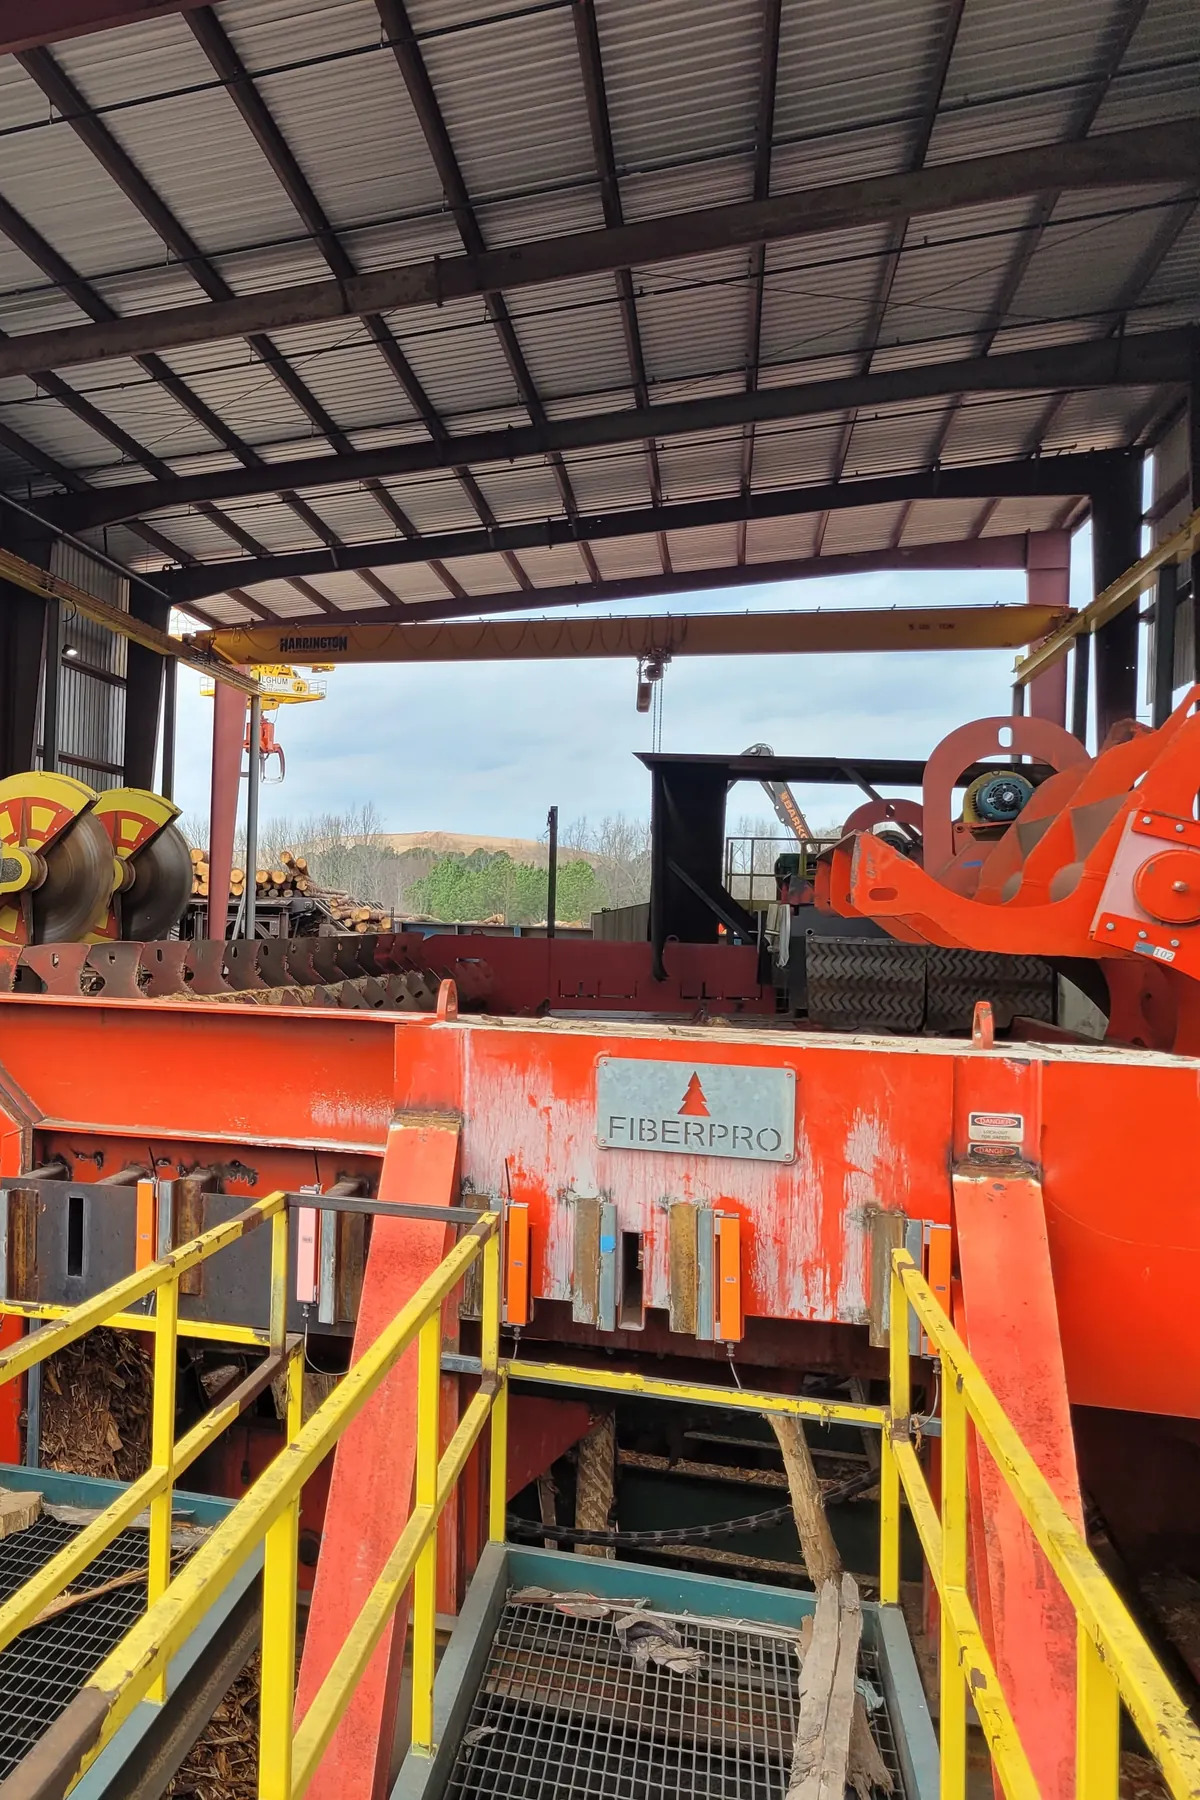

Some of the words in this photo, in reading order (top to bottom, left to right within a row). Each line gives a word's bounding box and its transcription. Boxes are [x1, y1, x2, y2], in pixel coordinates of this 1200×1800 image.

[280, 636, 348, 652] HARRINGTON
[1154, 948, 1174, 960] 102
[609, 1115, 782, 1152] FIBERPRO
